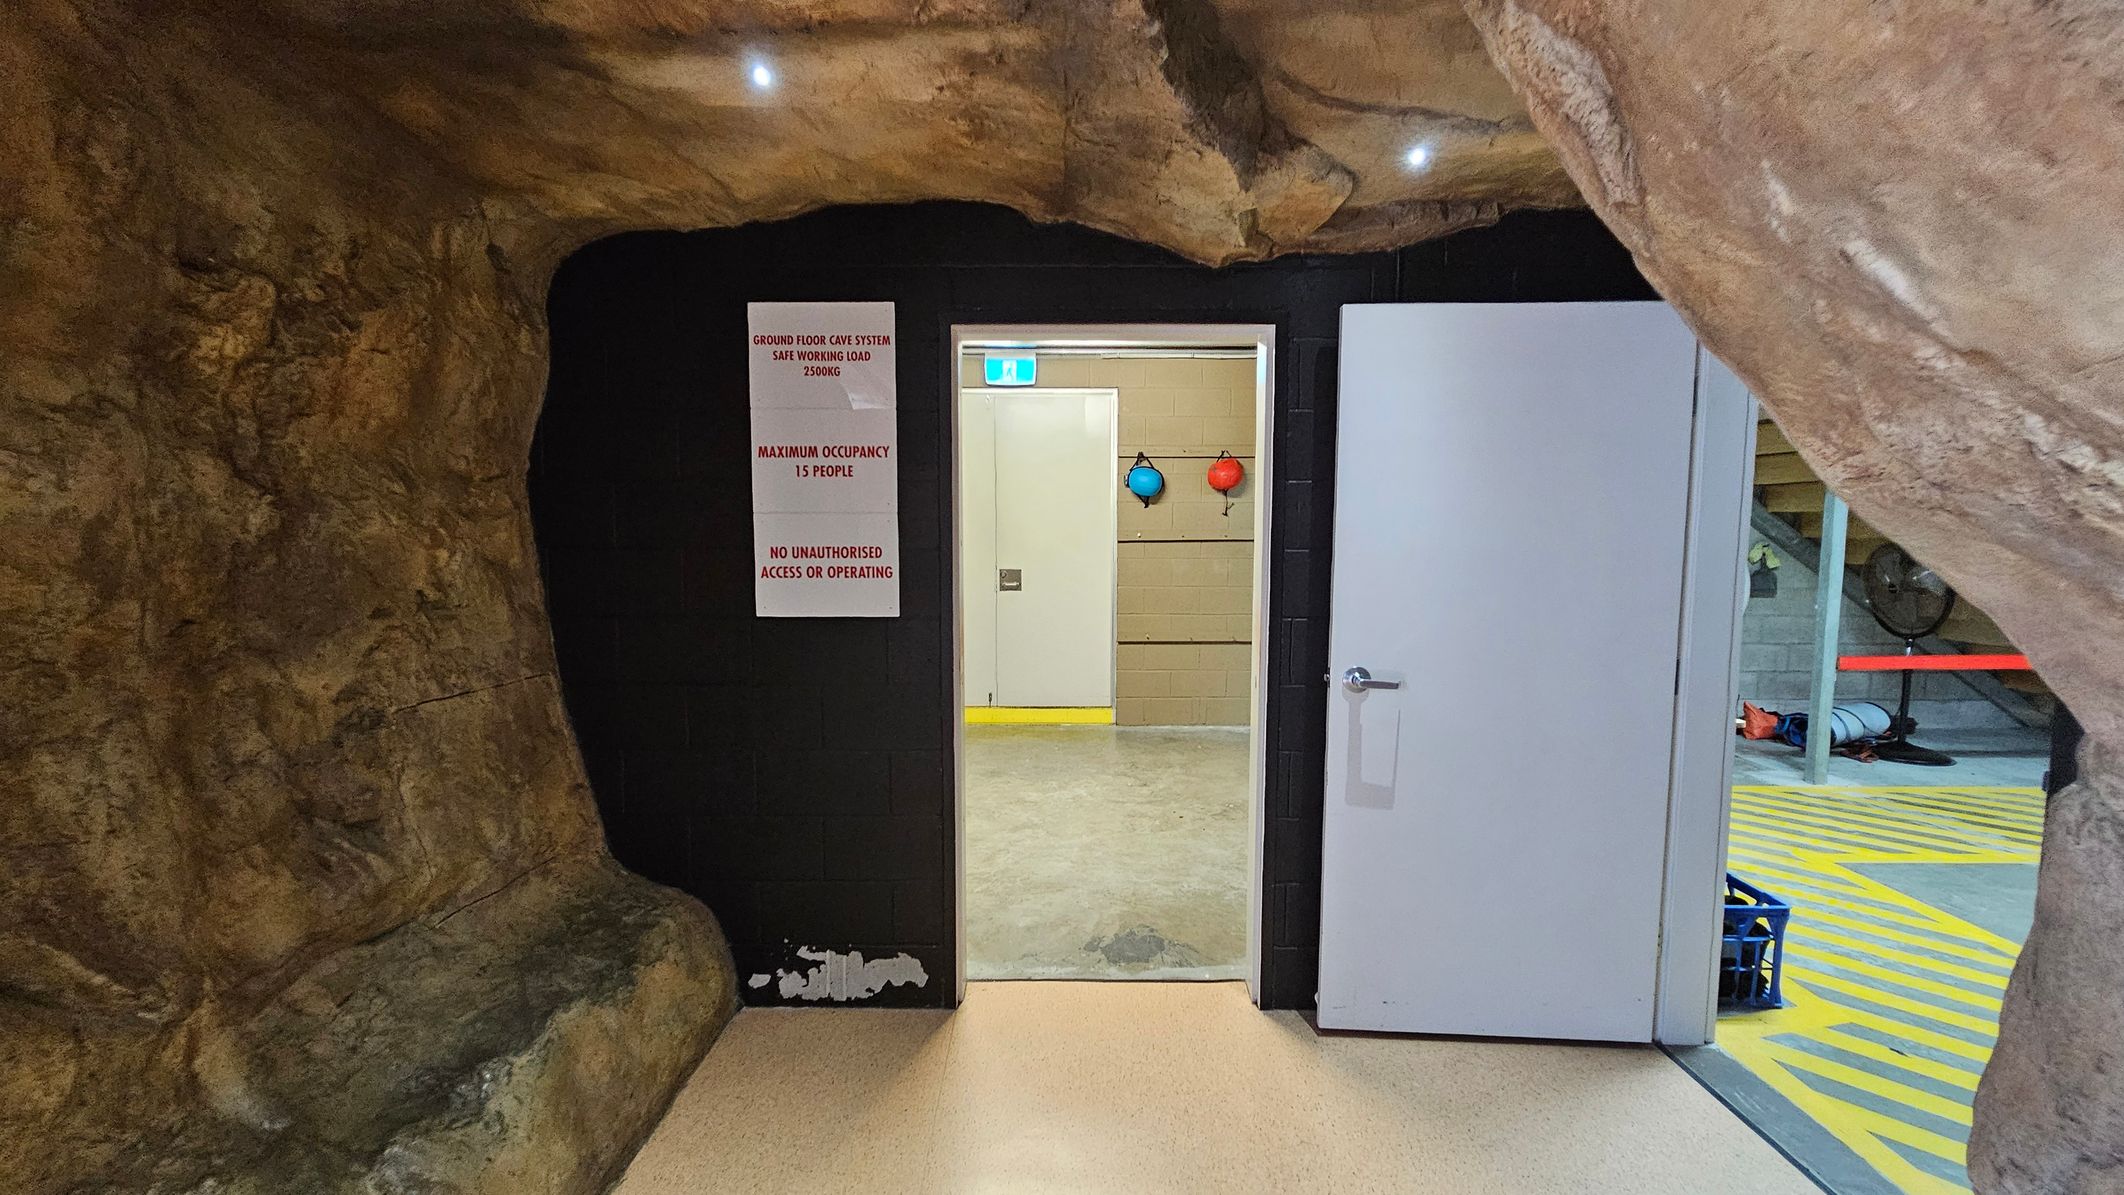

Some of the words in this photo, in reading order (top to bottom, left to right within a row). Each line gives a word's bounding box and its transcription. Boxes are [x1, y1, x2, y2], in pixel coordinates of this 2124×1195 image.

[753, 335, 794, 345] GROUND
[796, 335, 826, 345] FLOOR
[829, 335, 854, 346] CAVE
[856, 335, 890, 346] SYSTEM
[773, 351, 794, 361] SAFE
[797, 351, 844, 361] WORKING
[847, 351, 871, 361] LOAD
[804, 366, 840, 377] 2500KG
[758, 446, 818, 458] MAXIMUM
[822, 446, 889, 458] OCCUPANCY
[795, 465, 809, 477] 15
[813, 465, 853, 477] PEOPLE
[770, 547, 787, 559] NO
[792, 546, 882, 559] UNAUTHORISED
[761, 566, 802, 578] ACCESS
[806, 566, 823, 578] OR
[827, 566, 893, 579] OPERATING
